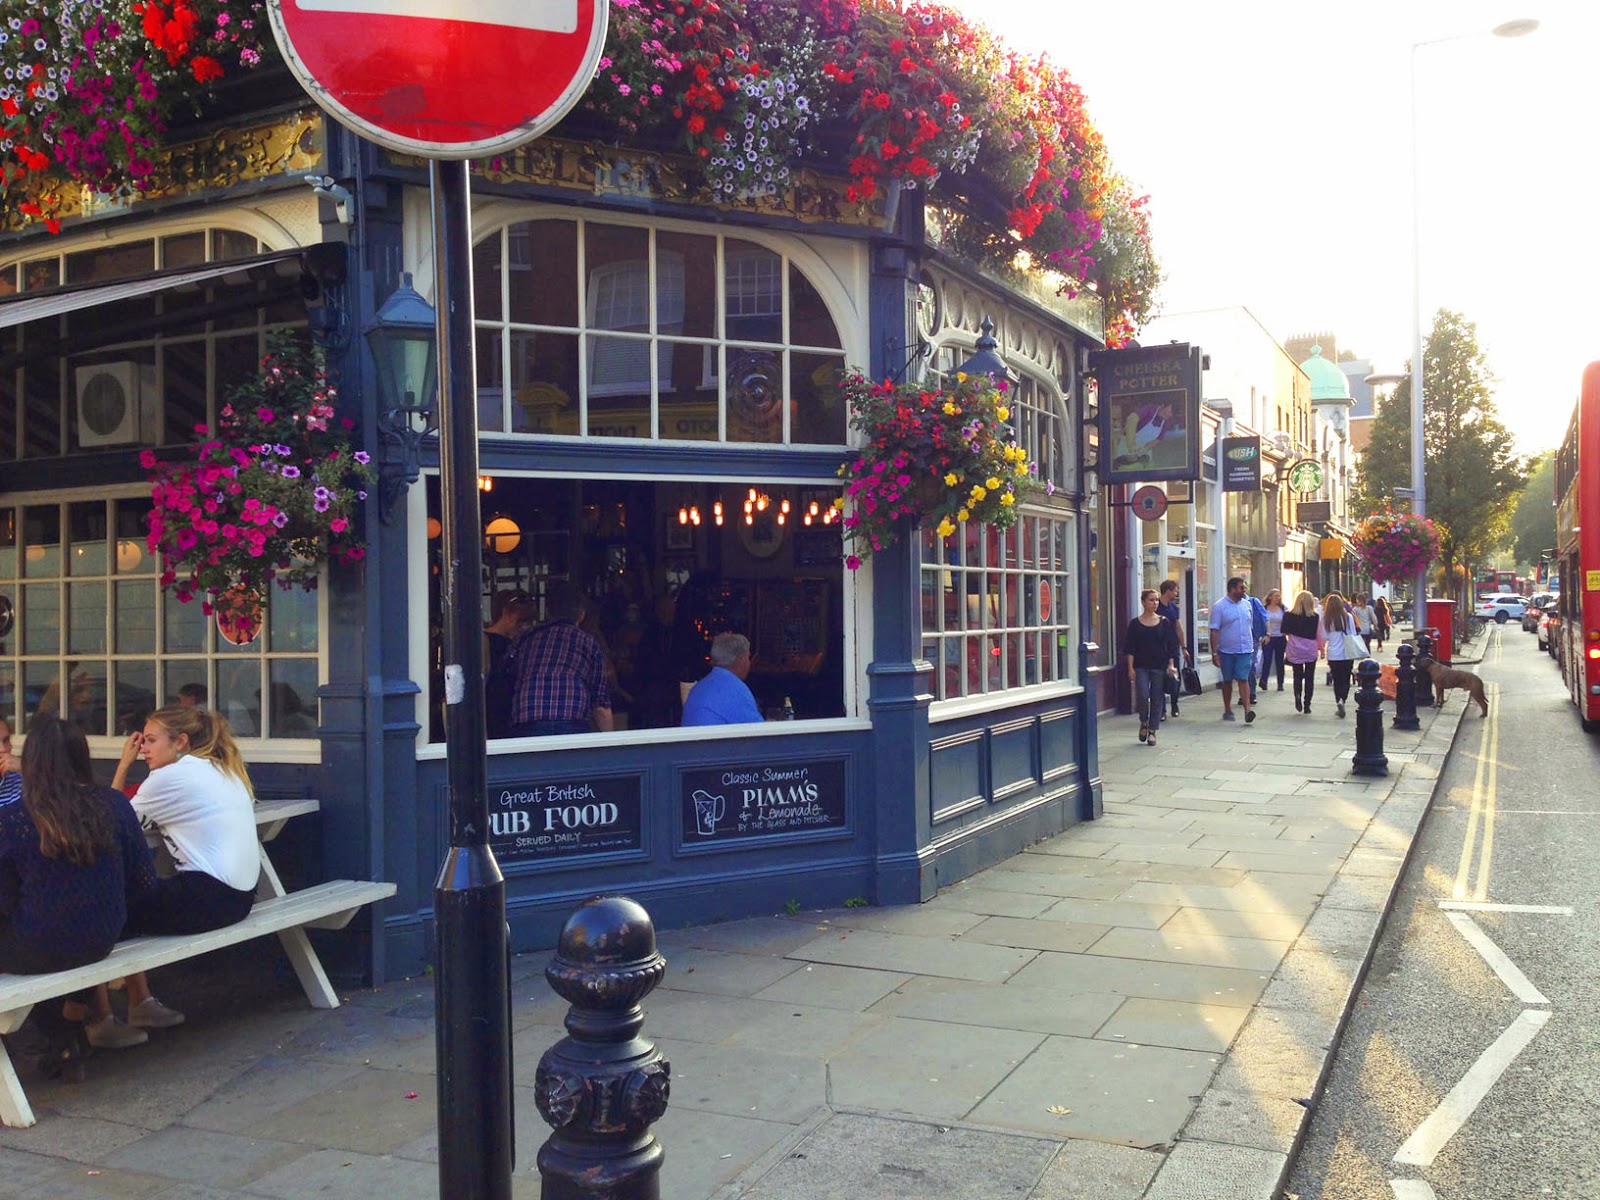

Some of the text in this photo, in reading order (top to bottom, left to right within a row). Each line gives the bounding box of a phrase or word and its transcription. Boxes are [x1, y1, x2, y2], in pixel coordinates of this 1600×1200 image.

[1114, 360, 1183, 377] CHELSEA
[1119, 374, 1178, 390] POTTER
[721, 767, 809, 786] Classic Summer
[500, 783, 596, 809] Great British
[741, 778, 819, 809] PIMM'S
[488, 802, 619, 836] UB FOOD
[757, 802, 823, 822] Lemonade
[737, 814, 831, 832] BY THE GLASS AND PITCHER
[515, 833, 552, 848] SERVED
[554, 831, 582, 844] DAILY
